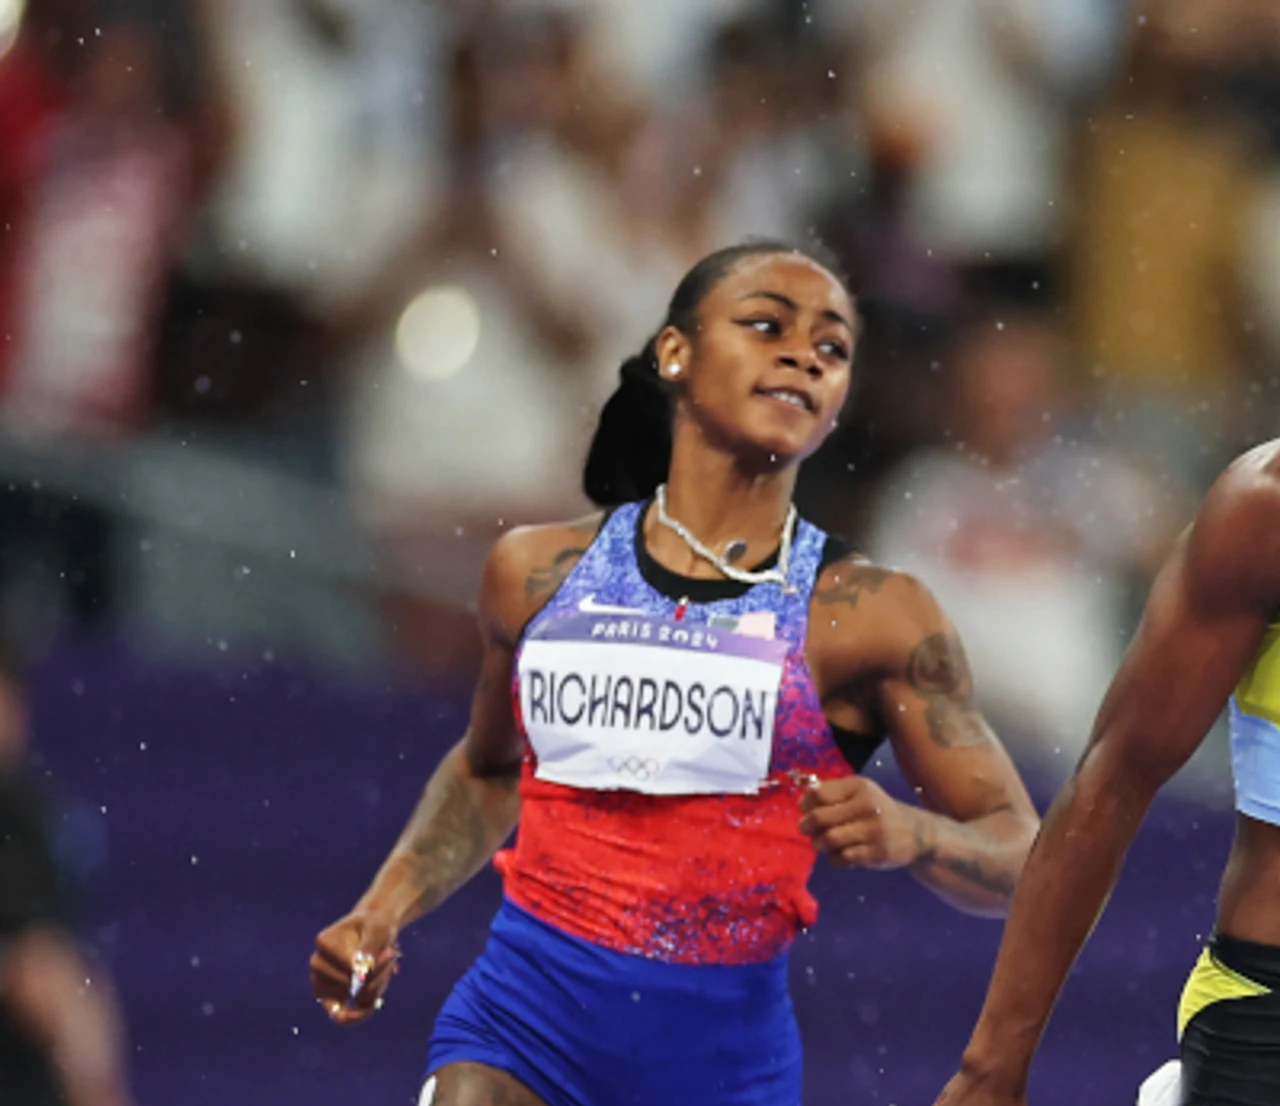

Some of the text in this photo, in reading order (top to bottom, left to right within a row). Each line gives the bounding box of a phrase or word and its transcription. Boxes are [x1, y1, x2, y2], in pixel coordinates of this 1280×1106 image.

[591, 622, 718, 650] PARIS 2024
[528, 670, 768, 739] RICHARDSON
